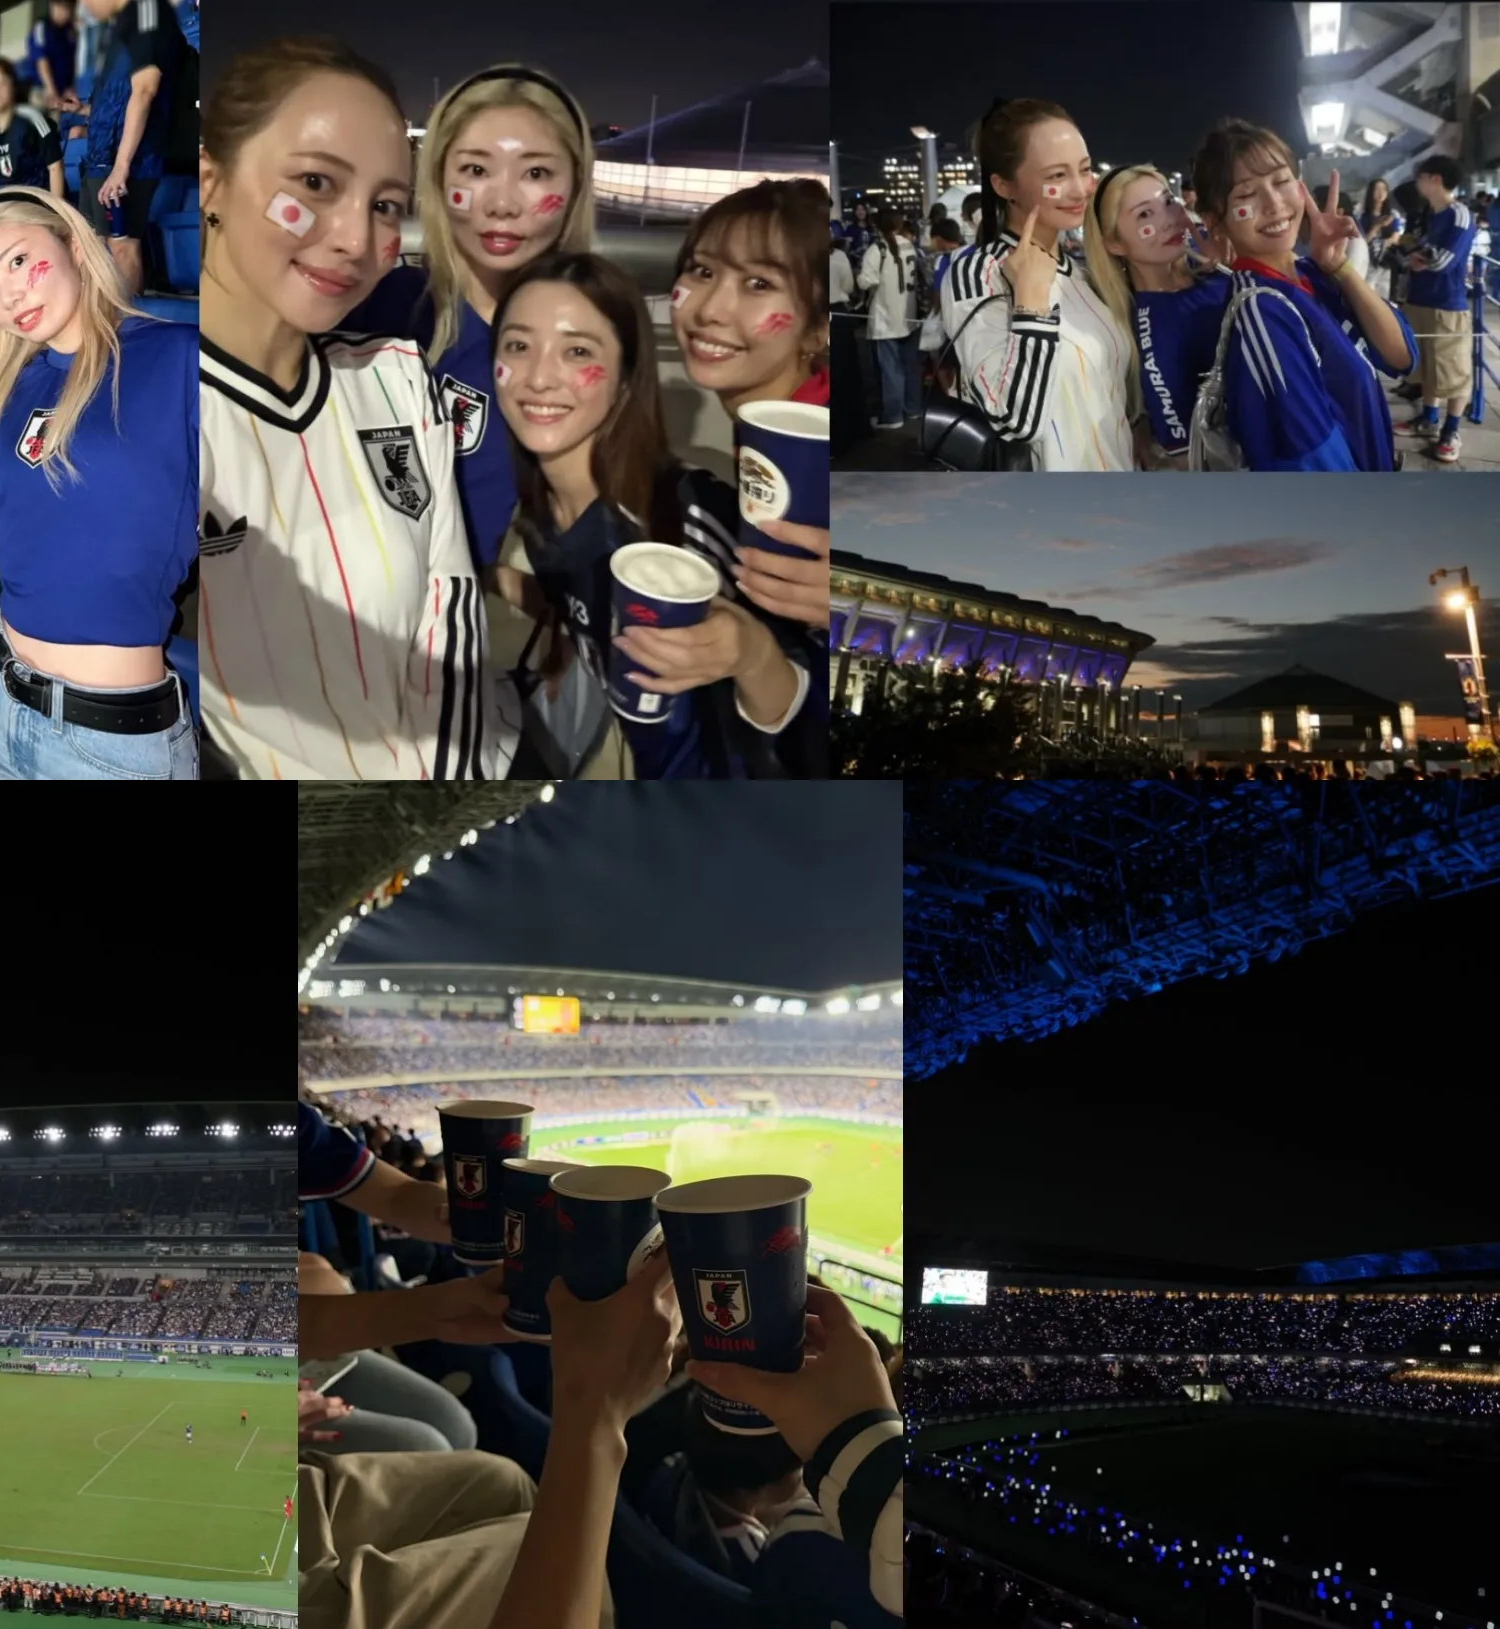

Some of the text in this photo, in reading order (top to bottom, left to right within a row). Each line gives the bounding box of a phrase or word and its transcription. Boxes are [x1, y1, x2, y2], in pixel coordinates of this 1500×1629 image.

[1138, 306, 1187, 439] SAMURAI BLUE
[452, 383, 478, 399] JAPAN
[371, 429, 402, 439] JAPAN
